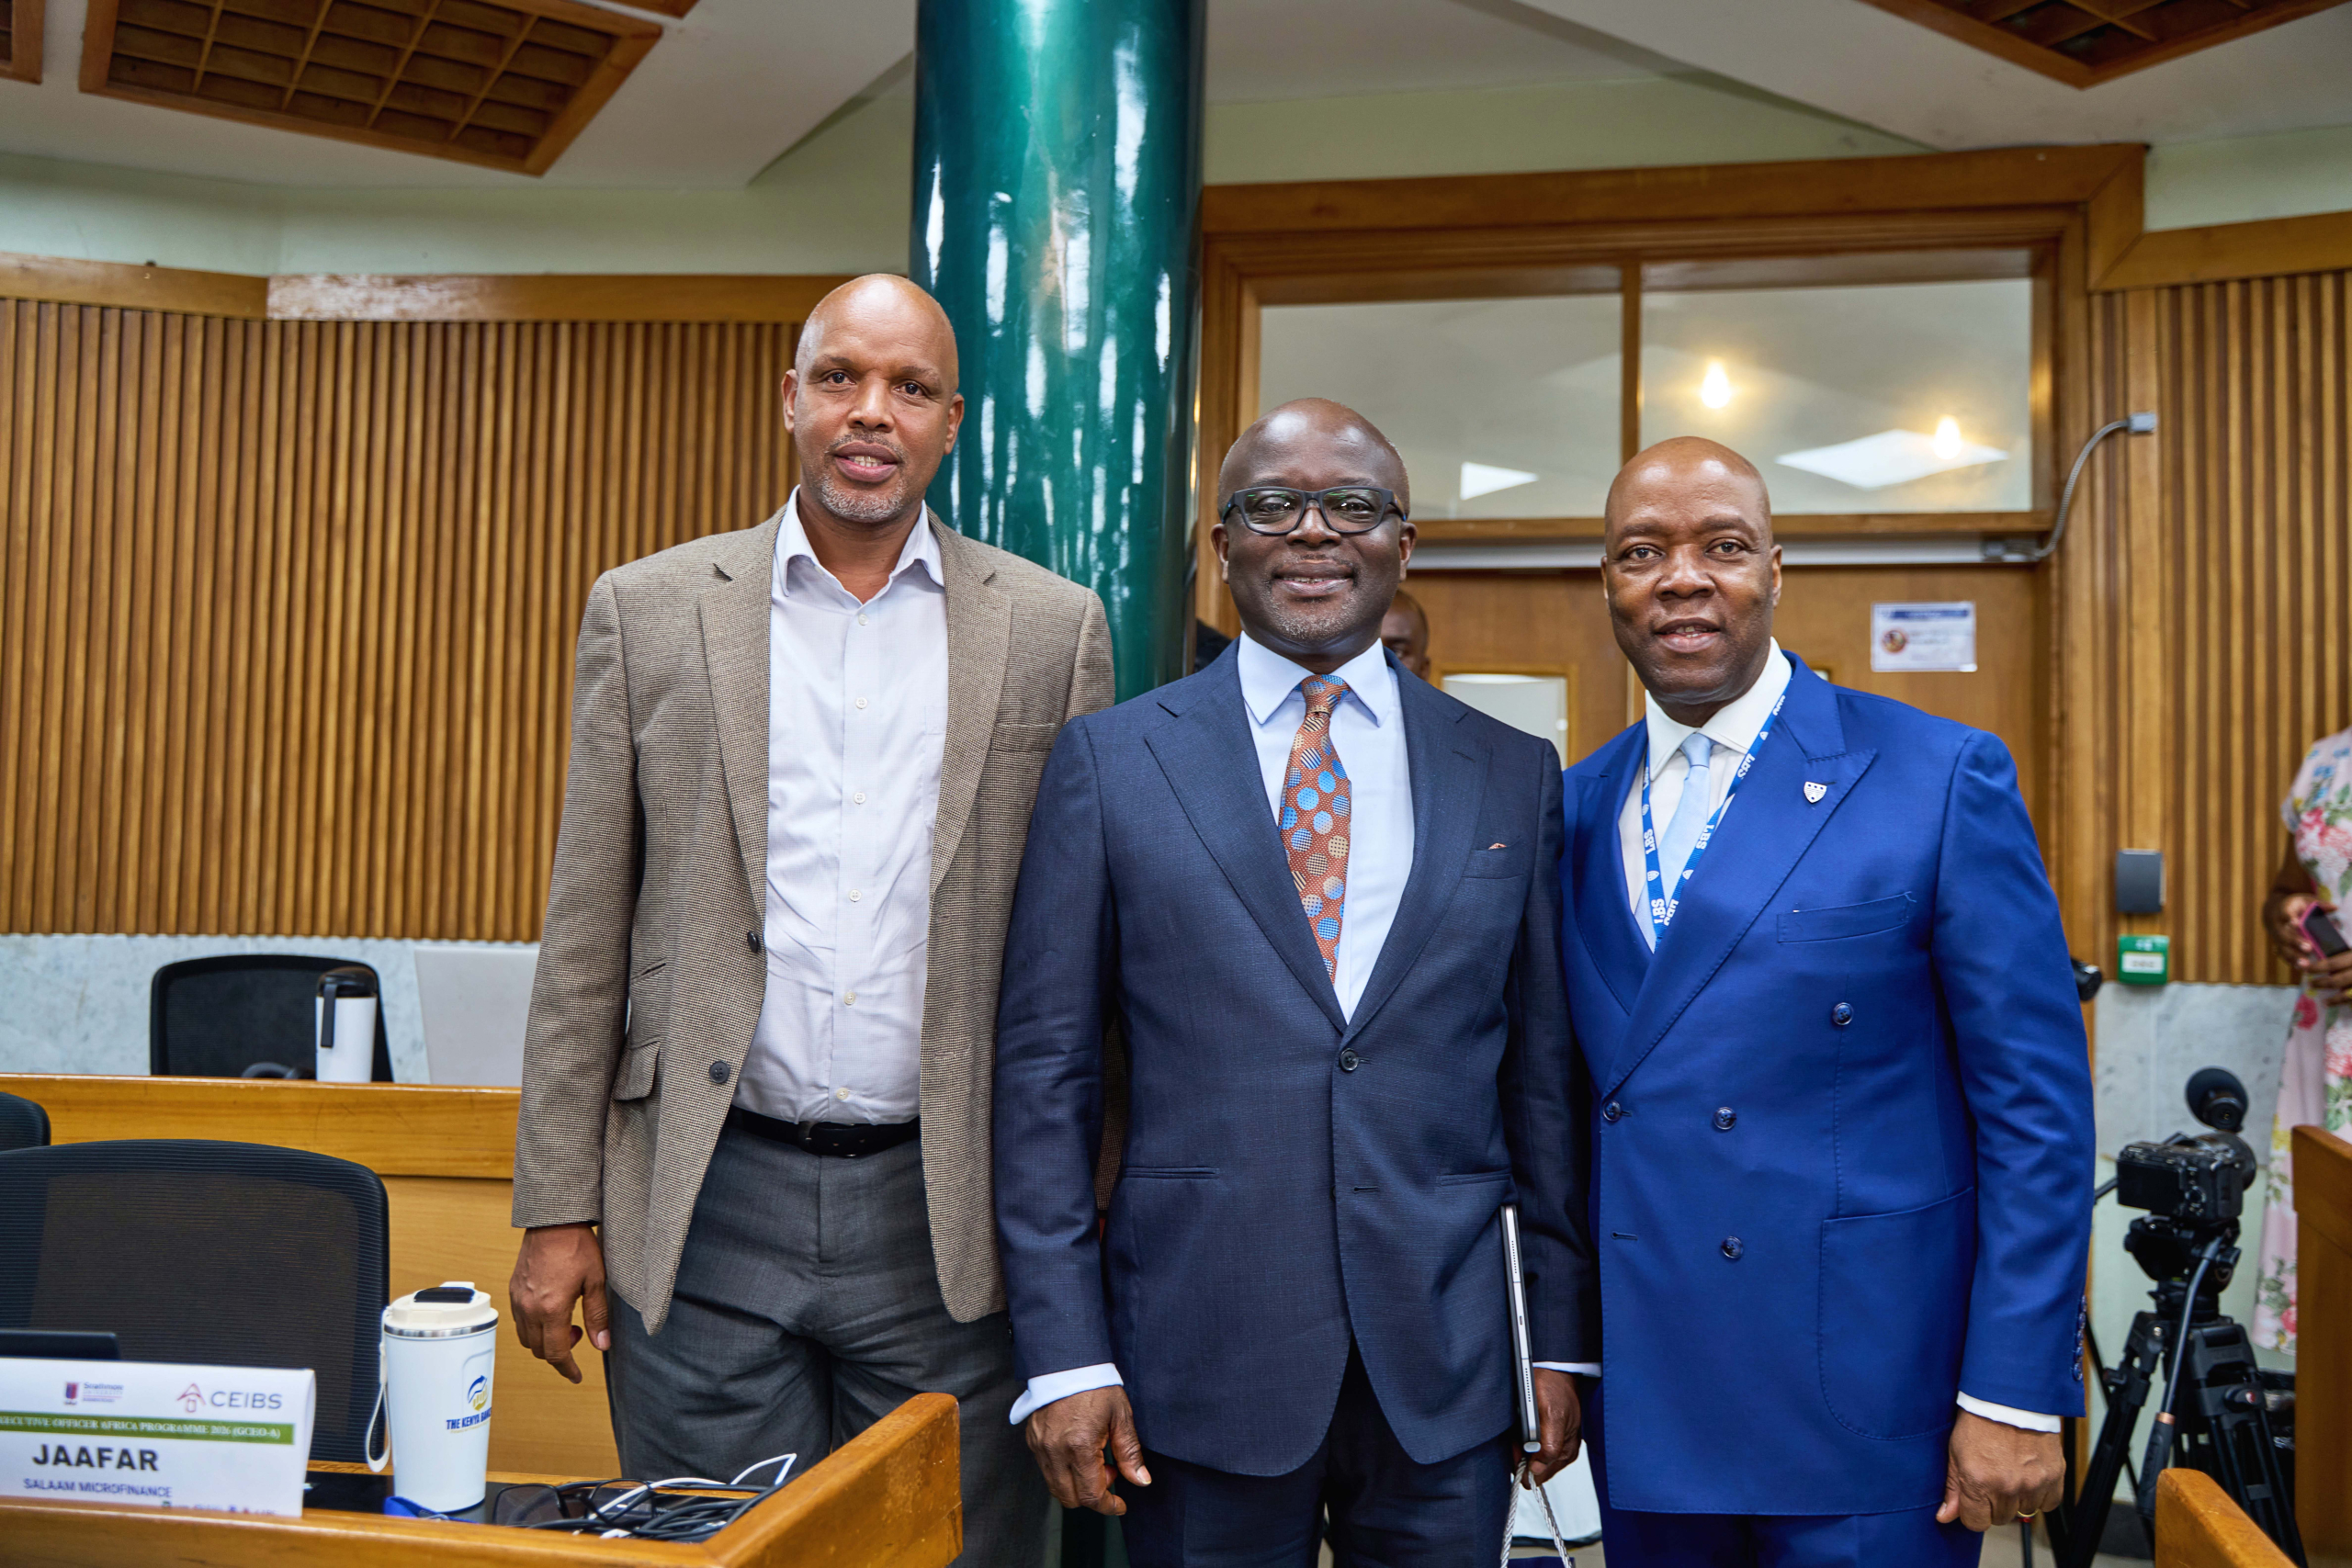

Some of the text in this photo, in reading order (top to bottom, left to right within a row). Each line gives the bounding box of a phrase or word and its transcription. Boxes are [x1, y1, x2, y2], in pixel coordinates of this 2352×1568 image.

[1644, 828, 1657, 855] LBS
[1695, 824, 1715, 851] LBS
[210, 1391, 282, 1410] CEIBS
[51, 1417, 98, 1429] OFFICER
[101, 1420, 138, 1431] AFRICA
[139, 1422, 209, 1434] PROGRAMME
[447, 1418, 460, 1429] THE
[32, 1444, 159, 1472] JAAFAR
[24, 1478, 173, 1497] SALAAM MICROFINANCE
